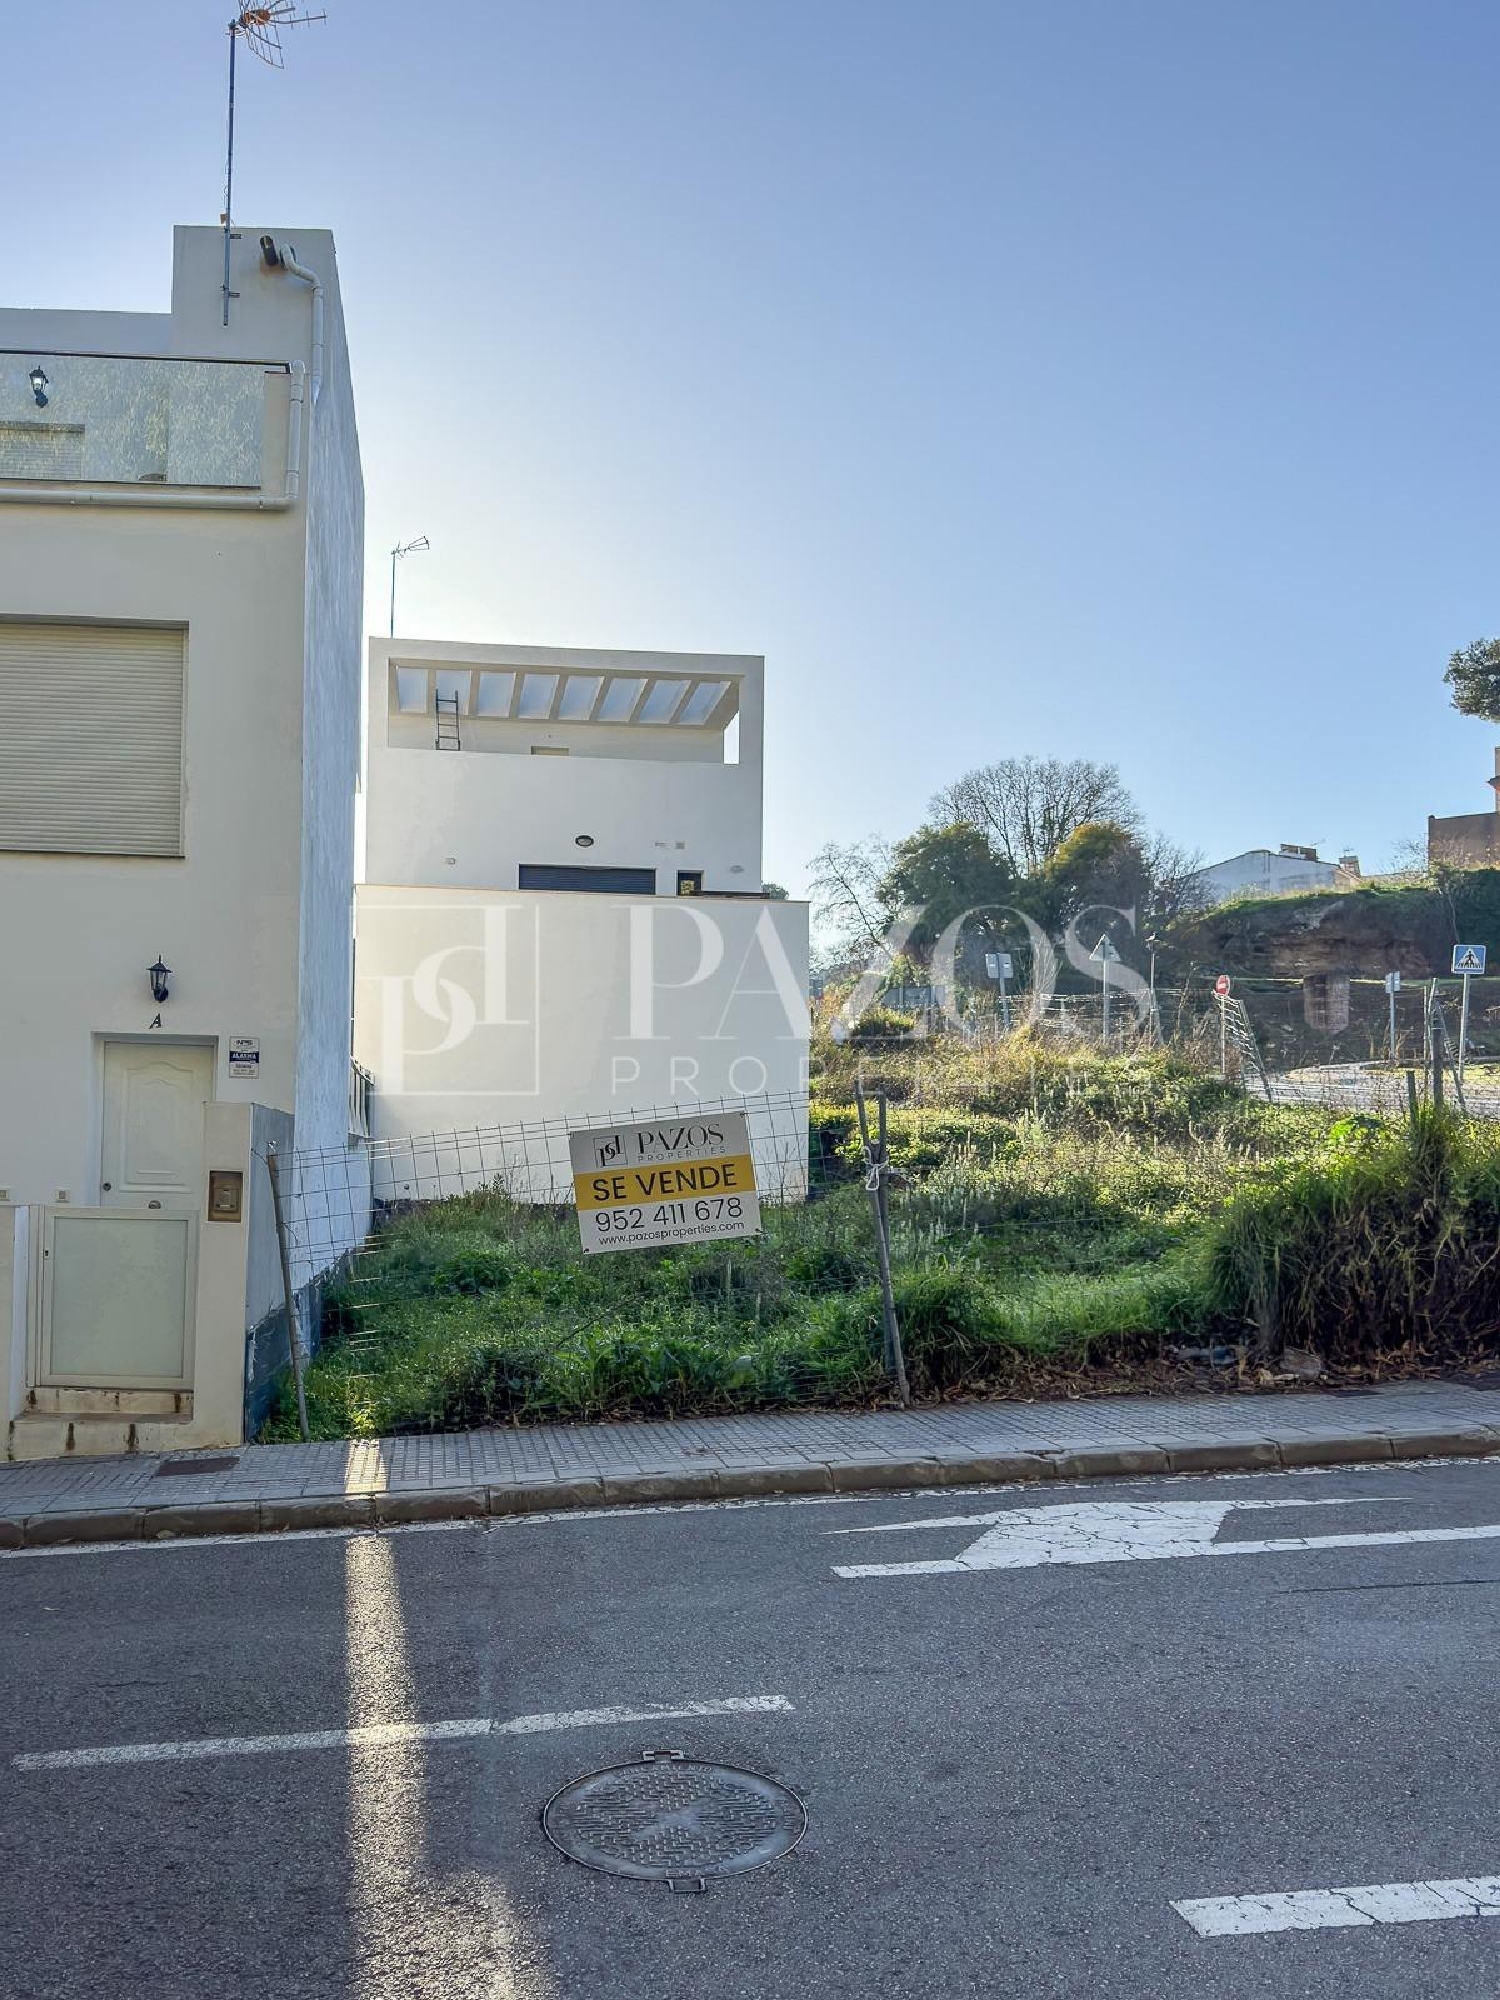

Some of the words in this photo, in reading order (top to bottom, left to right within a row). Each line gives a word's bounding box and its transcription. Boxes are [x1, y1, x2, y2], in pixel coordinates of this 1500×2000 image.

[148, 1012, 162, 1029] A
[637, 1123, 724, 1154] PAZOS
[637, 1145, 726, 1161] PROPERTIES
[593, 1175, 627, 1201] SE
[635, 1163, 737, 1196] VENDE
[595, 1208, 645, 1232] 952
[653, 1203, 686, 1226] 411
[695, 1197, 742, 1221] 678
[598, 1220, 745, 1246] www.pazosproperties.com
